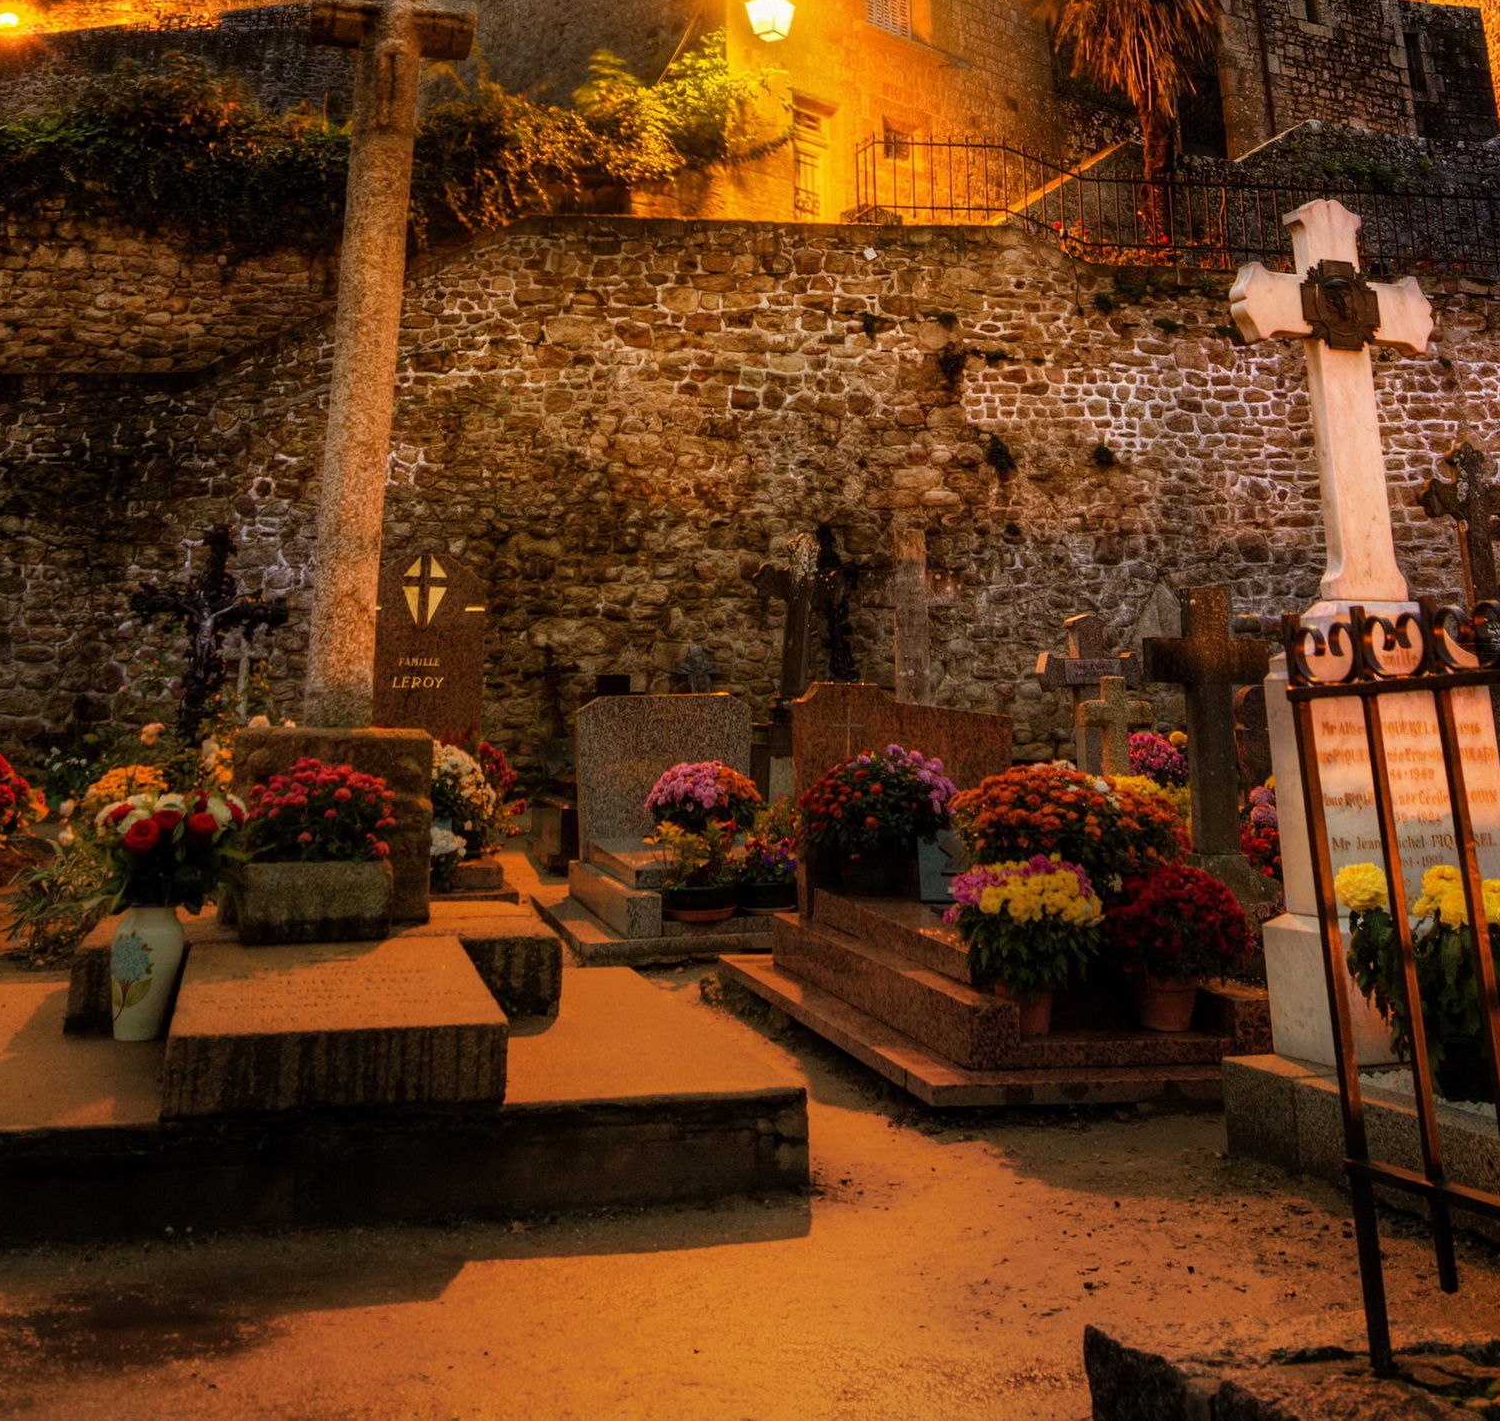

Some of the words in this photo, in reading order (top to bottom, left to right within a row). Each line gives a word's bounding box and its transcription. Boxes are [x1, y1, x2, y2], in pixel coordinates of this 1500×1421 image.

[398, 657, 440, 667] FAMILLE
[392, 676, 444, 689] LEROY
[1339, 721, 1367, 735] Albe
[1382, 721, 1430, 738] IQUEREL
[1332, 837, 1351, 852] Mr
[1356, 836, 1382, 850] Jean
[1398, 835, 1426, 850] ichel
[1431, 832, 1498, 851] PIQREL
